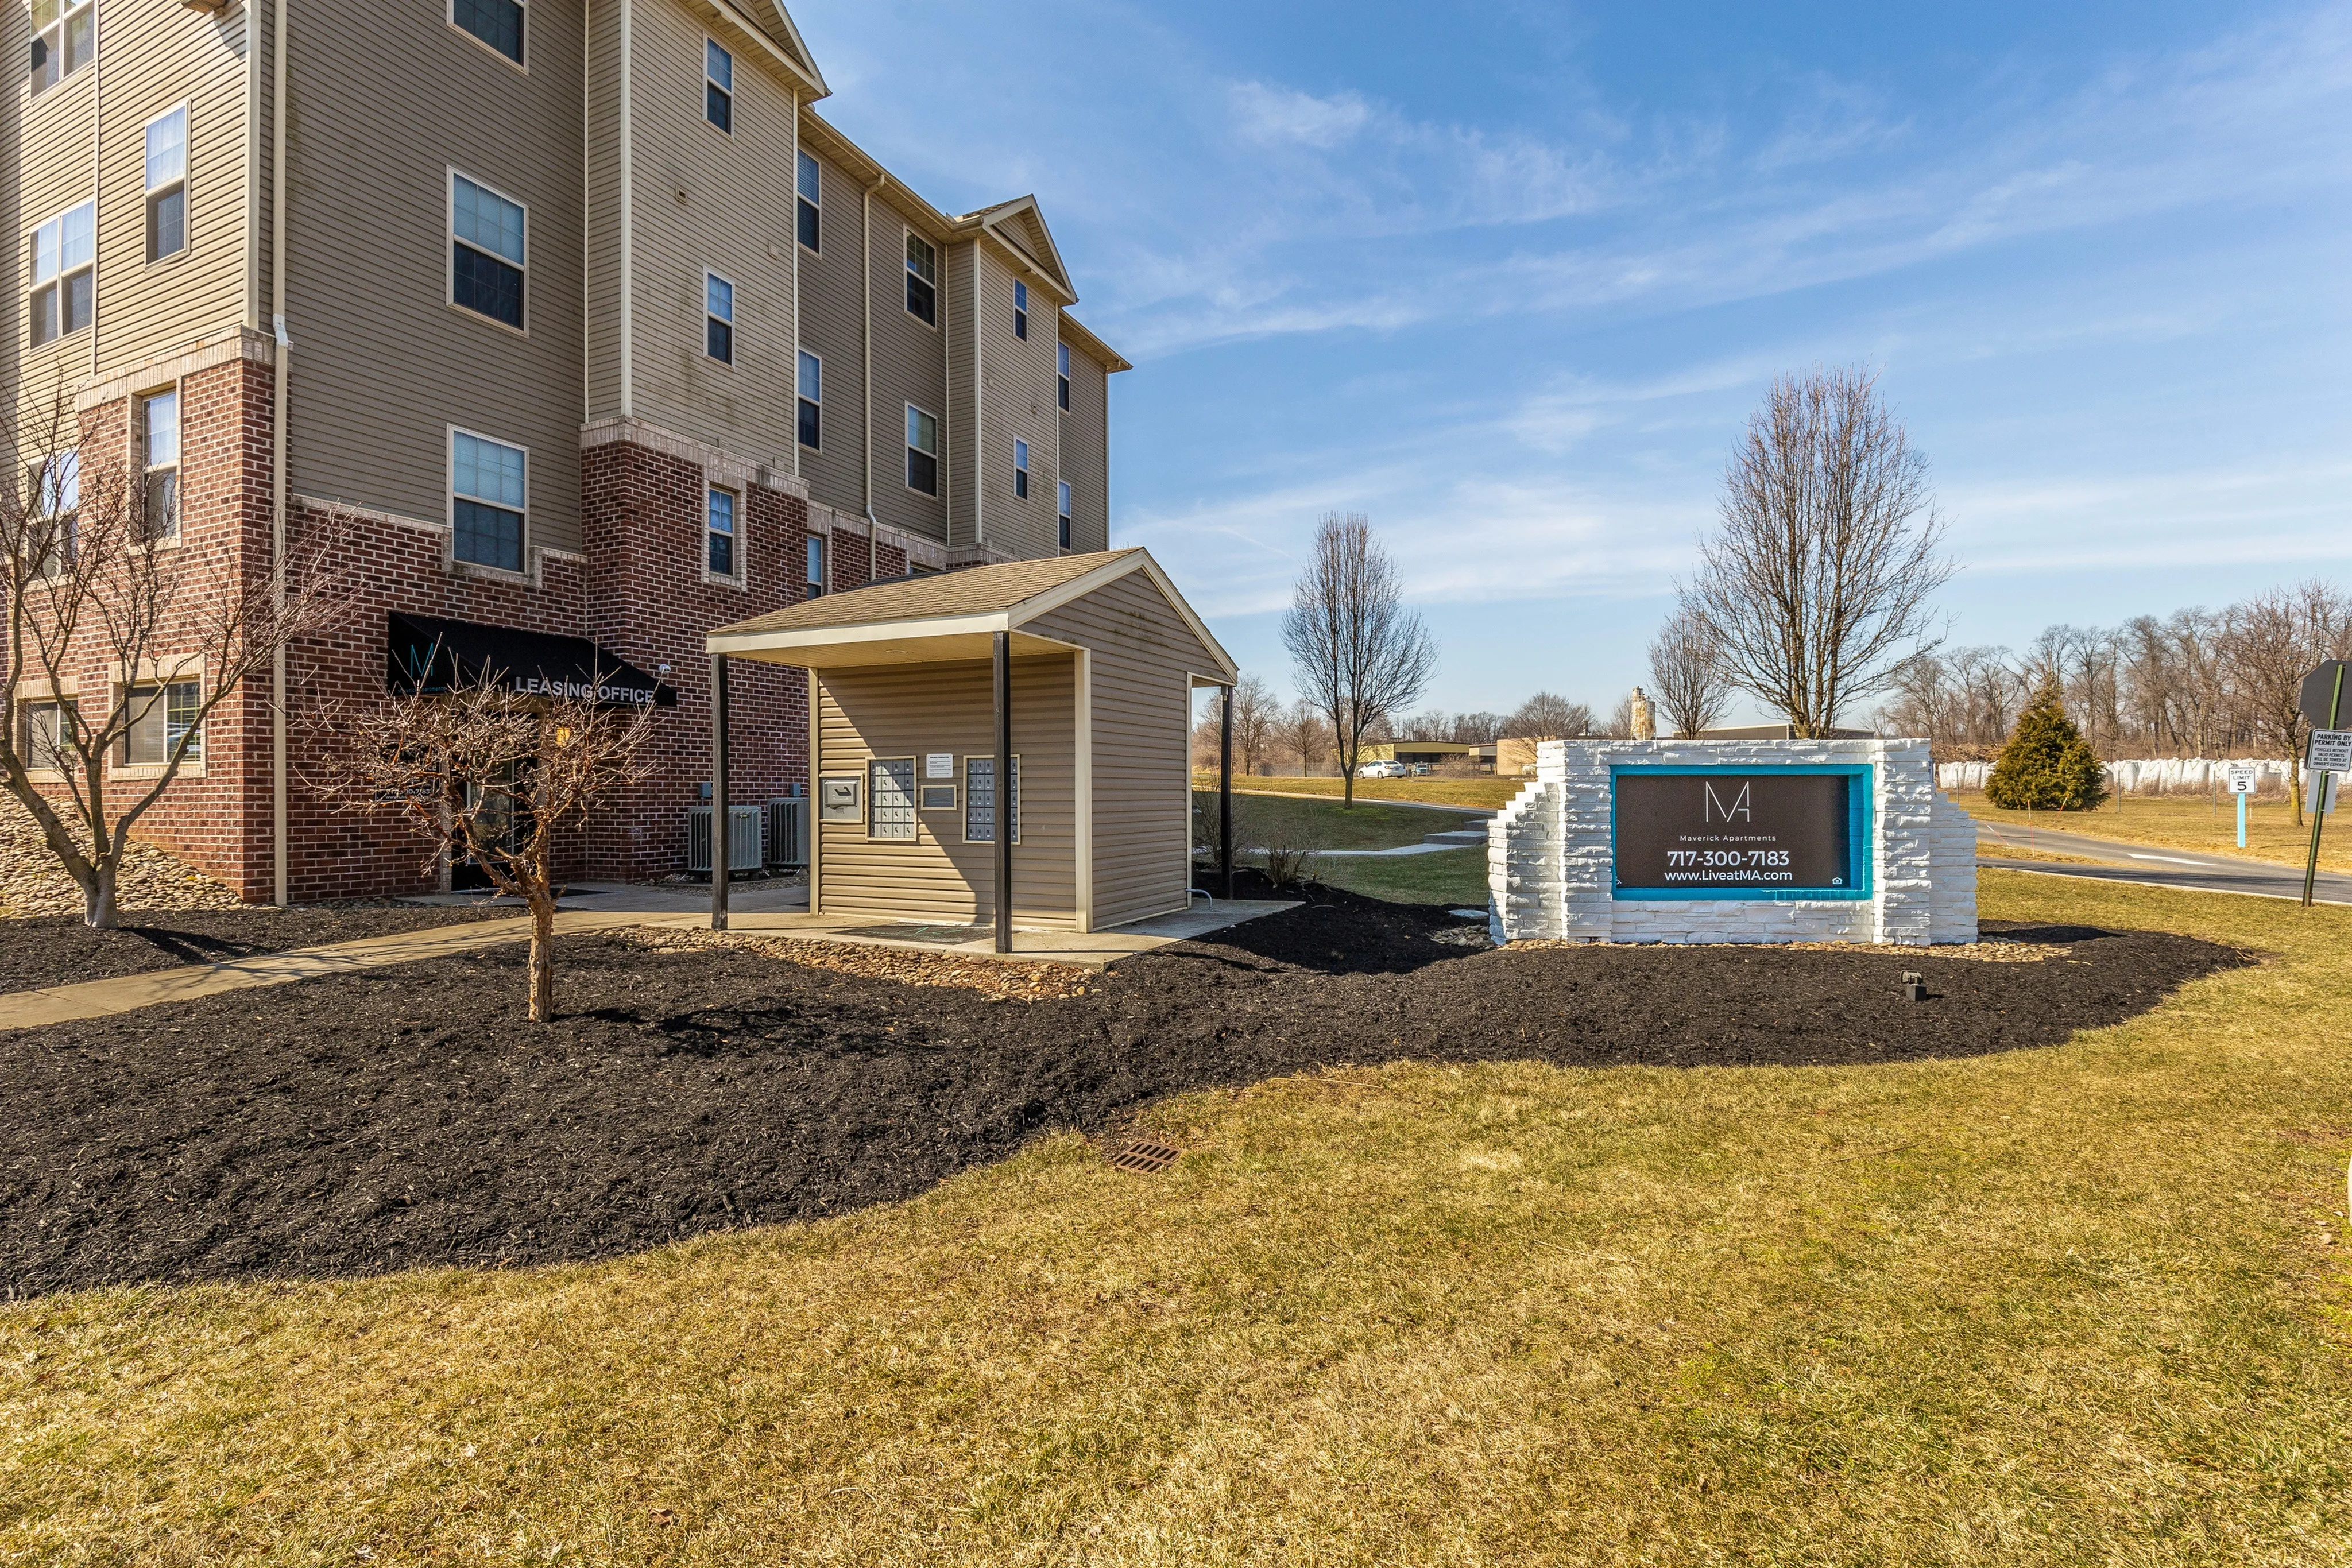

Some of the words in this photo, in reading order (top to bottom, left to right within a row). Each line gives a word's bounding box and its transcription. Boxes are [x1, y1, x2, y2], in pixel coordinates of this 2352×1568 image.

[516, 676, 594, 699] LEASING
[598, 685, 656, 703] OFFICE
[2237, 781, 2247, 791] 5
[1667, 851, 1790, 866] 717-300-7183
[1664, 870, 1793, 881] www.LiveatMA.com
